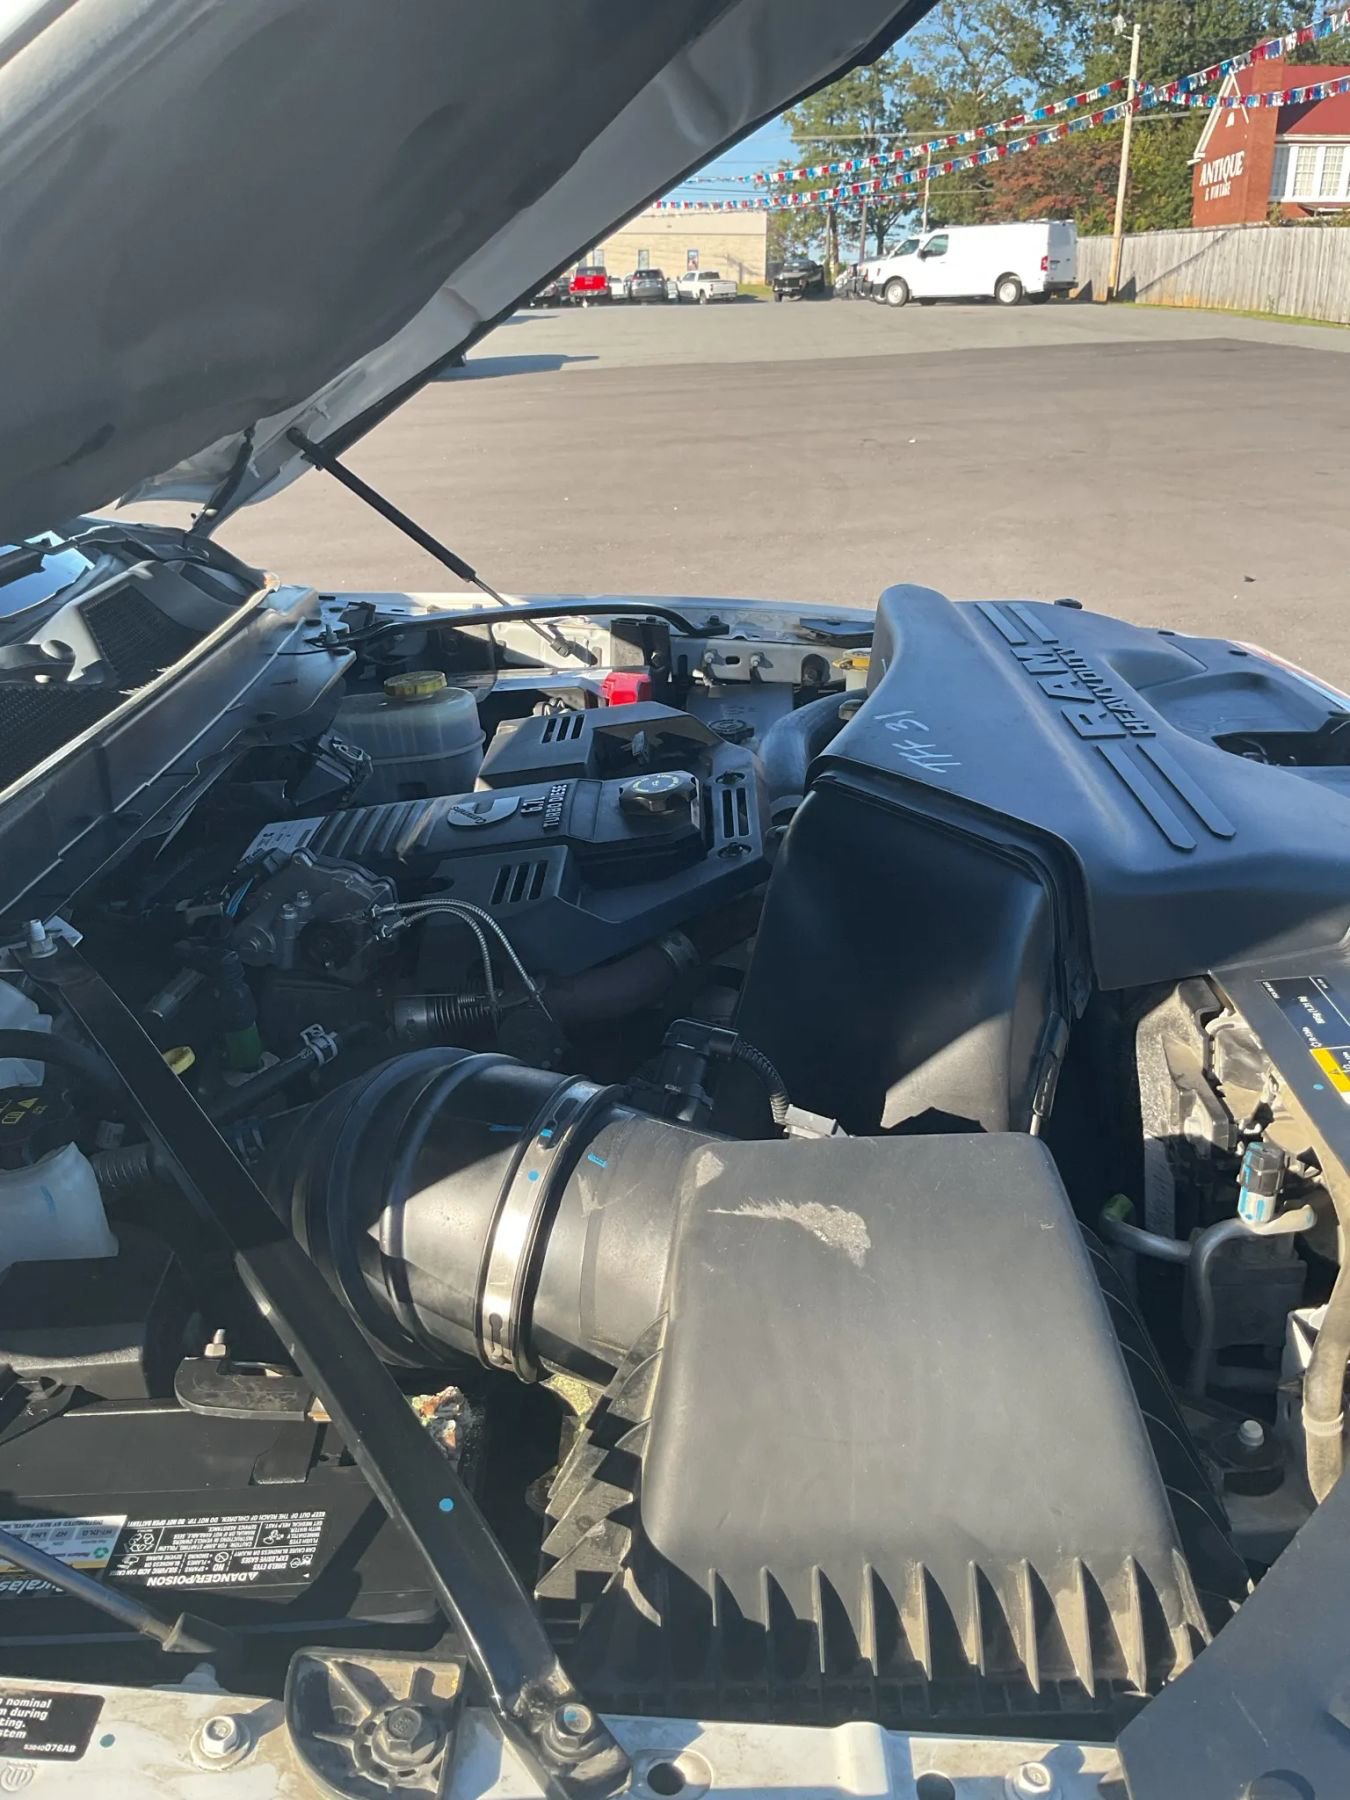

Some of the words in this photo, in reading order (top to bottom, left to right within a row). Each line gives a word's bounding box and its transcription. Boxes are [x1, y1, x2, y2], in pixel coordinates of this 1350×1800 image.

[1199, 150, 1245, 187] ANTIQUE
[1052, 646, 1103, 683] DUTY
[1010, 647, 1126, 740] RAM
[1086, 683, 1156, 737] HEAVY
[548, 784, 568, 803] DIESE
[543, 802, 562, 827] TURBO
[212, 1563, 225, 1572] NO
[147, 1572, 248, 1586] DANGER/POISON
[5, 1697, 52, 1709] nominal
[10, 1708, 48, 1721] during
